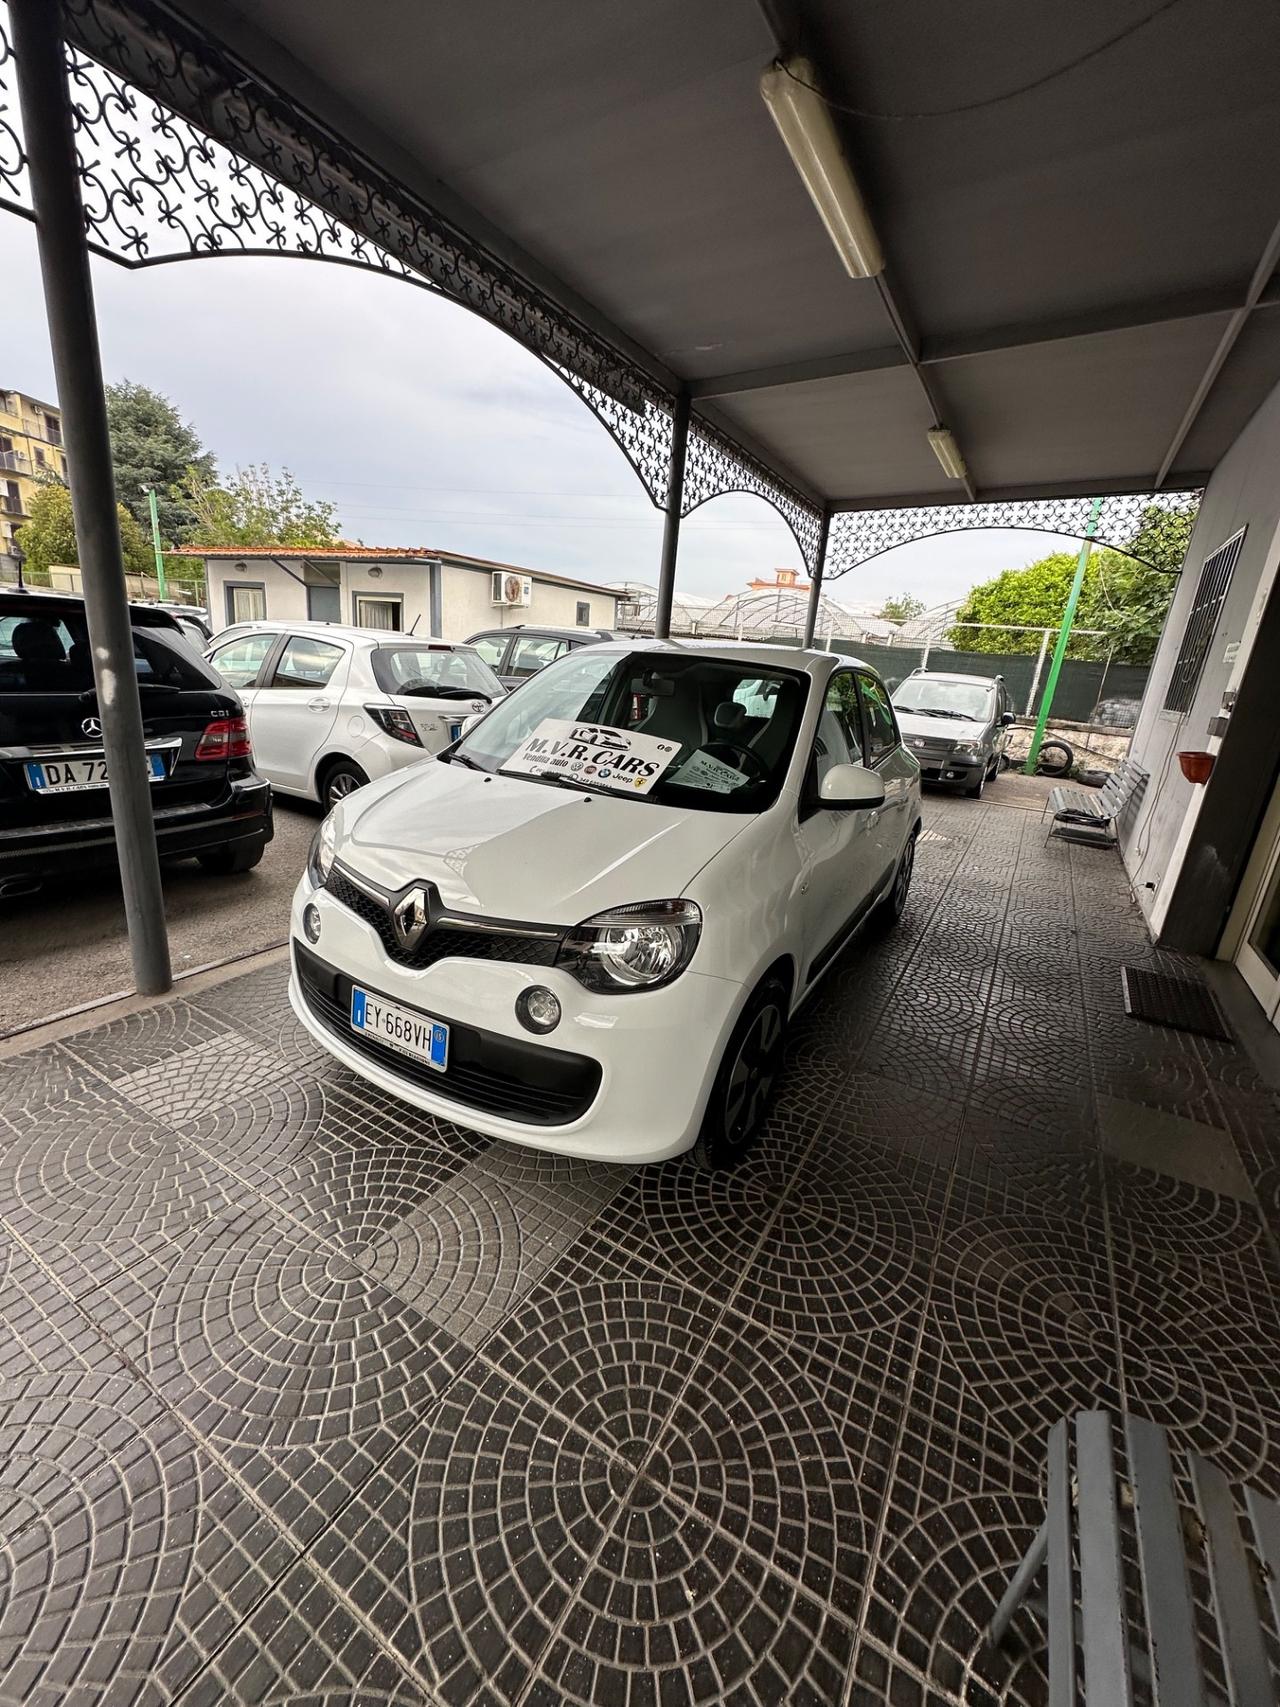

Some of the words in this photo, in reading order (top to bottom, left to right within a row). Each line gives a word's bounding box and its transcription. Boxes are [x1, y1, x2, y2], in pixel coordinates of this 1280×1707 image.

[550, 758, 569, 768] auto
[591, 750, 660, 777] CARS
[45, 763, 77, 786] DA
[612, 773, 633, 784] Jeep
